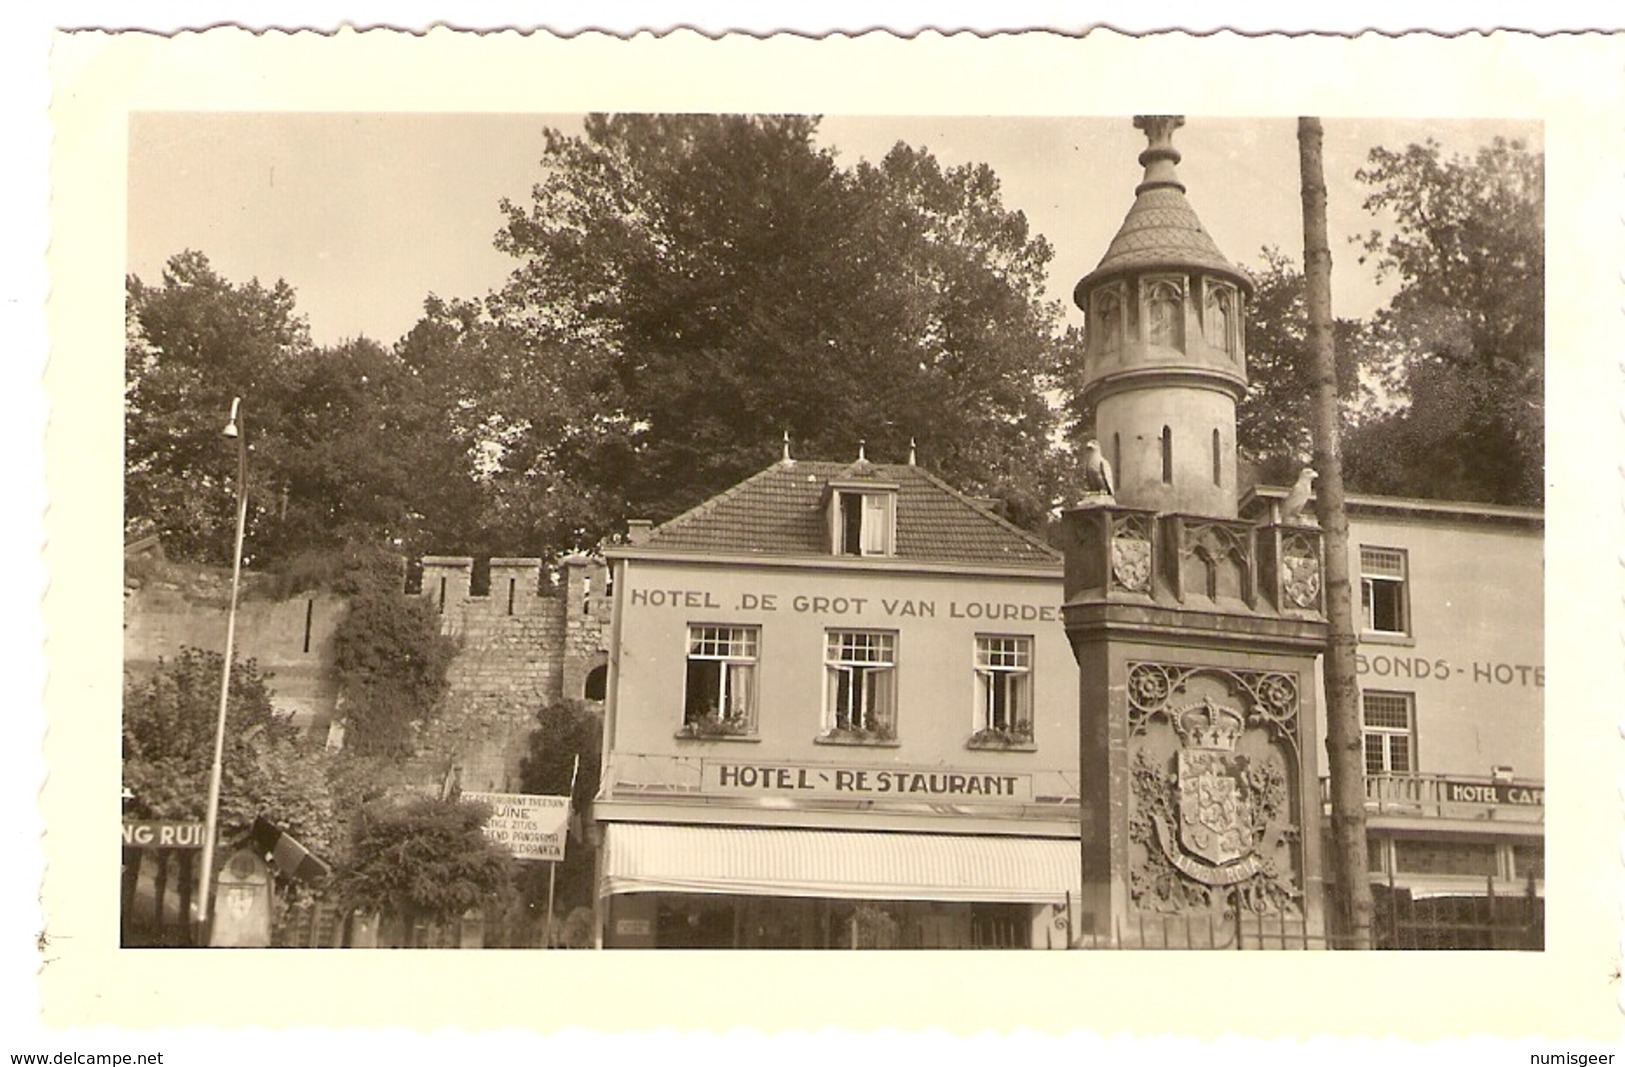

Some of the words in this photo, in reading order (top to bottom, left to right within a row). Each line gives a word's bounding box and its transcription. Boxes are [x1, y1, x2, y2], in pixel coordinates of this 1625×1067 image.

[631, 588, 720, 609] HOTEL
[792, 595, 868, 615] GROT
[881, 599, 936, 618] VAN
[1453, 784, 1500, 804] HOTEL
